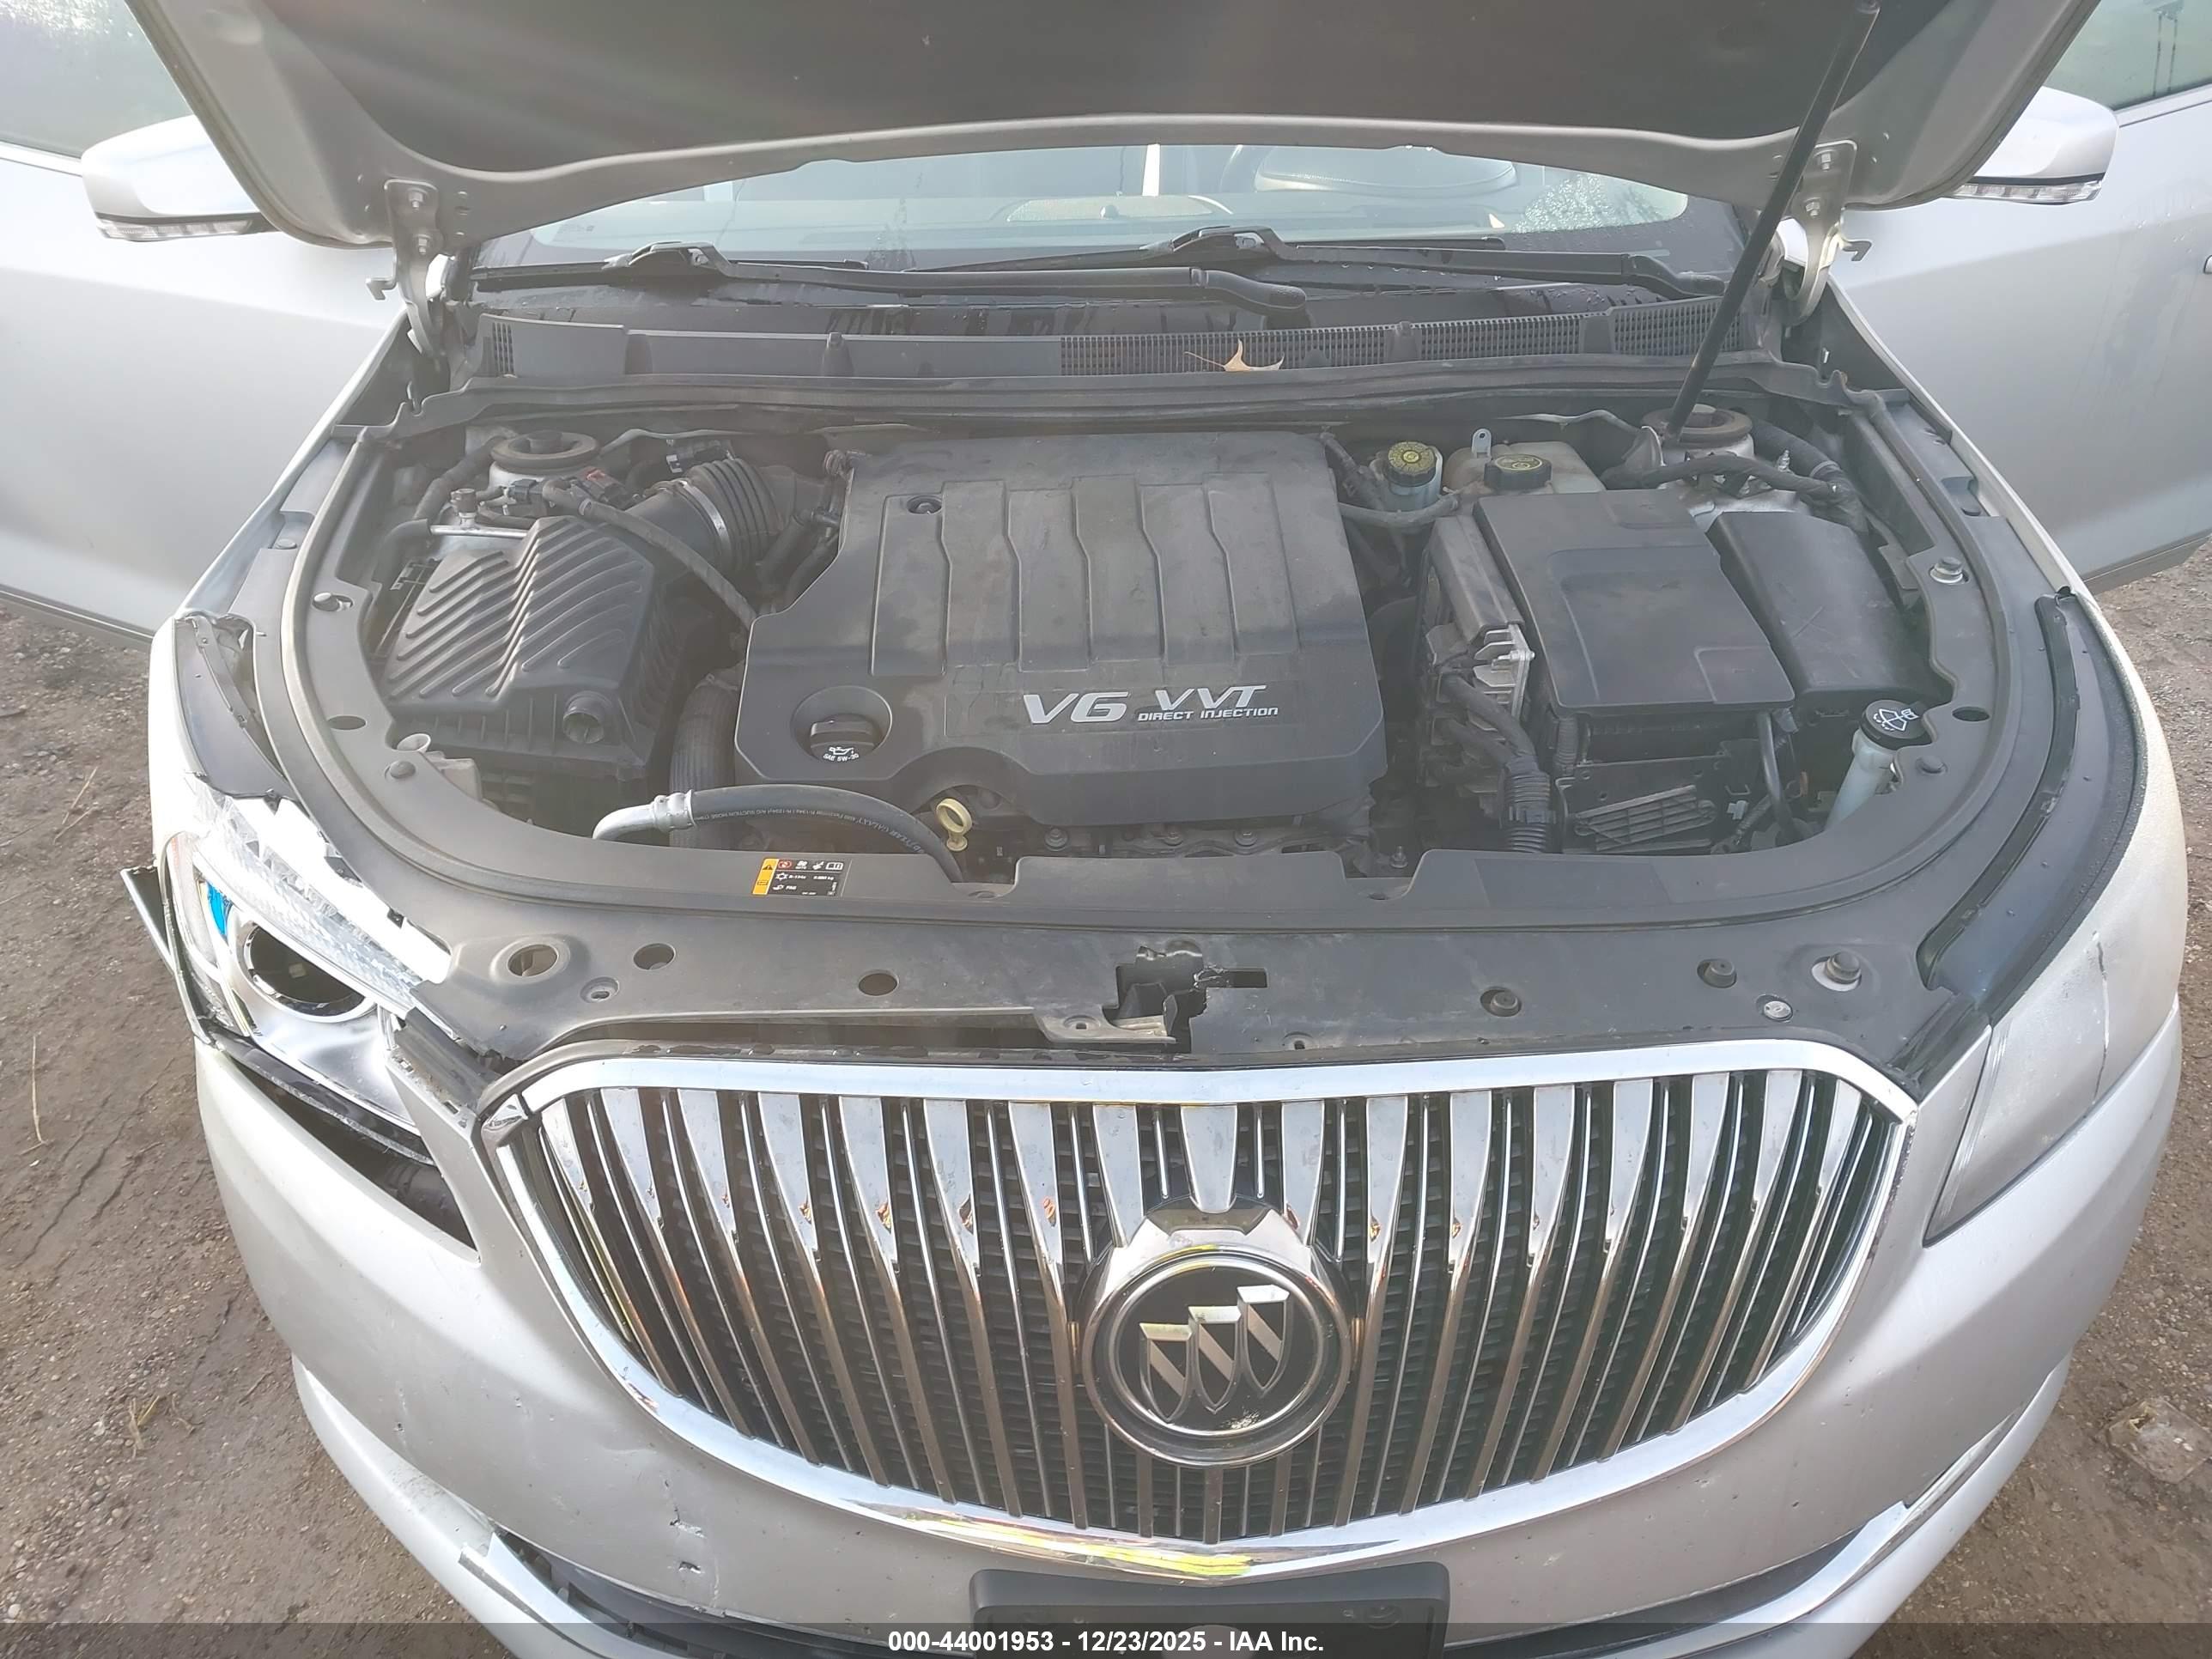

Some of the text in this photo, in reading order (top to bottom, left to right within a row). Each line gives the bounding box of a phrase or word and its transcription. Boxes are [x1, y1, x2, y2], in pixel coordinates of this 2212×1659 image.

[1023, 685, 1267, 724] V6 VVT
[1138, 707, 1279, 721] DIRECT INJECTION
[823, 753, 836, 762] SAE
